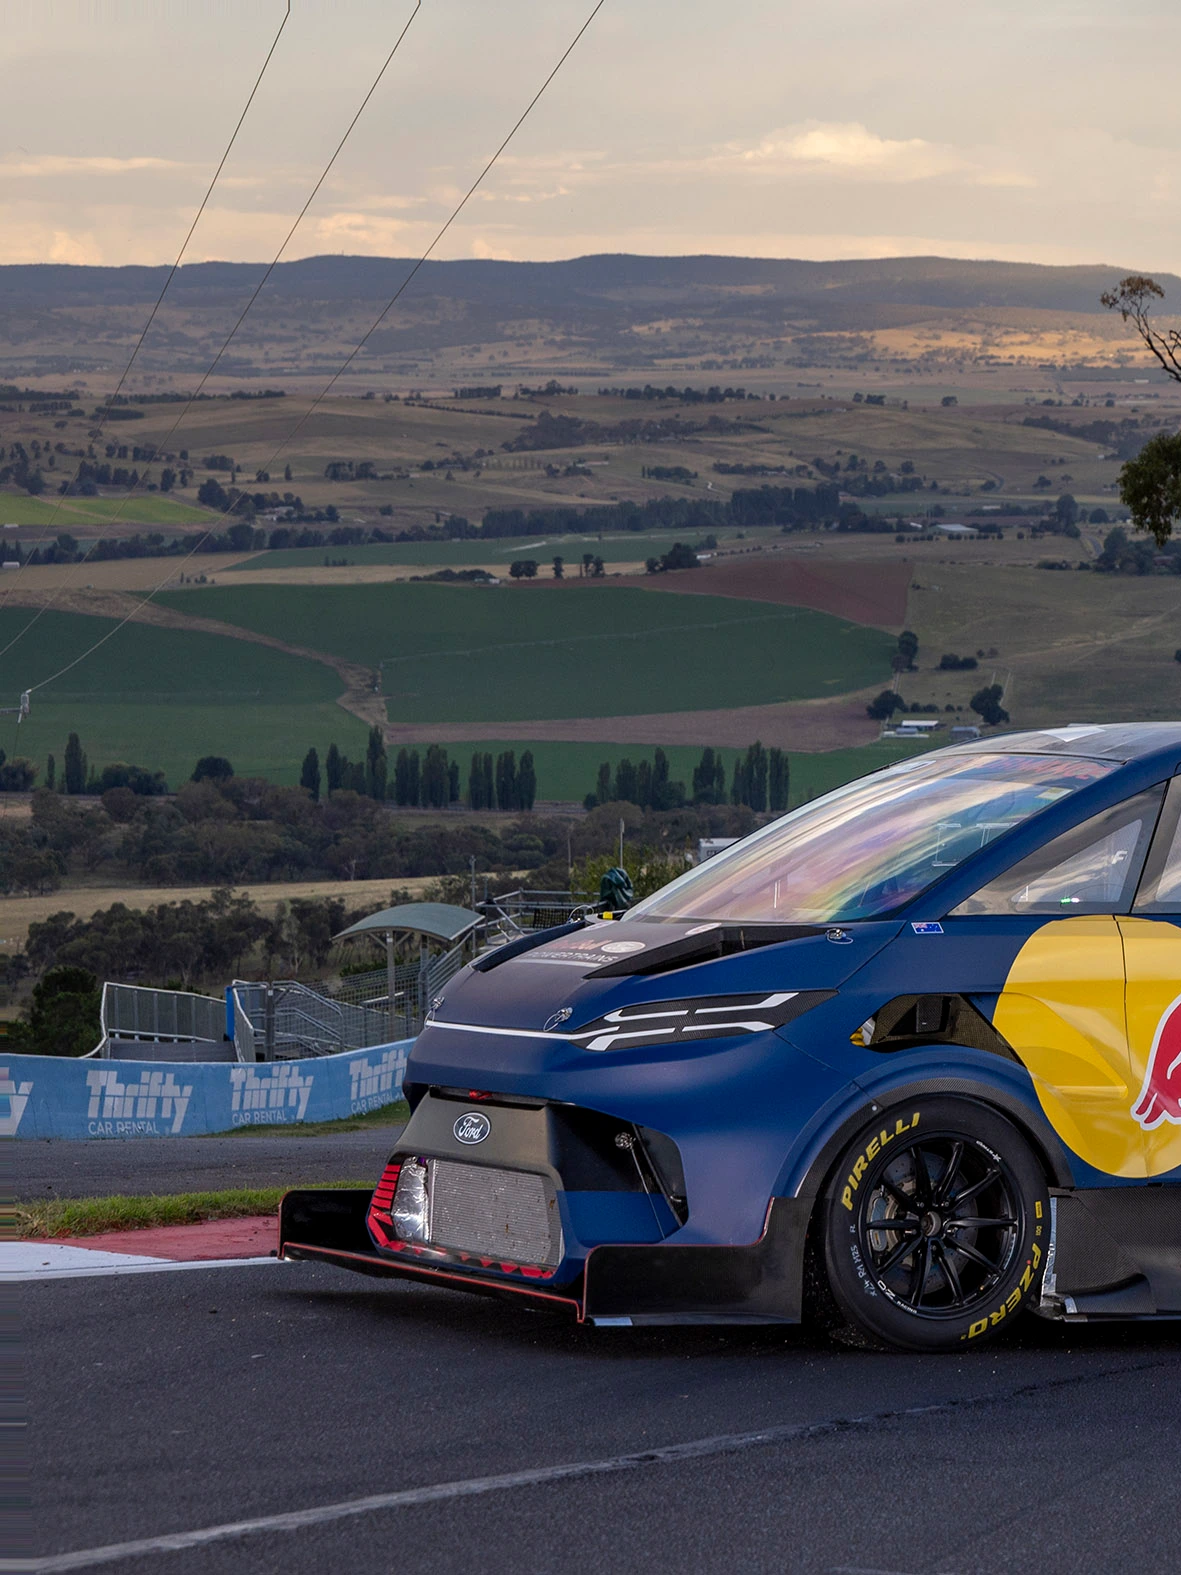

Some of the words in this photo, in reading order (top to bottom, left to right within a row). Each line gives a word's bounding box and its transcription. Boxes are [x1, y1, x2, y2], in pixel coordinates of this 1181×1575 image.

[86, 1070, 193, 1133] Thrifty
[229, 1065, 314, 1120] Thrifty
[351, 1101, 368, 1114] CAR
[368, 1091, 398, 1107] RENTAL
[88, 1121, 113, 1136] CAR
[116, 1120, 160, 1136] RENTAL
[232, 1112, 251, 1126] CAR
[254, 1110, 287, 1123] RENTAL
[458, 1116, 484, 1139] Ford
[842, 1112, 920, 1211] PIRELLI
